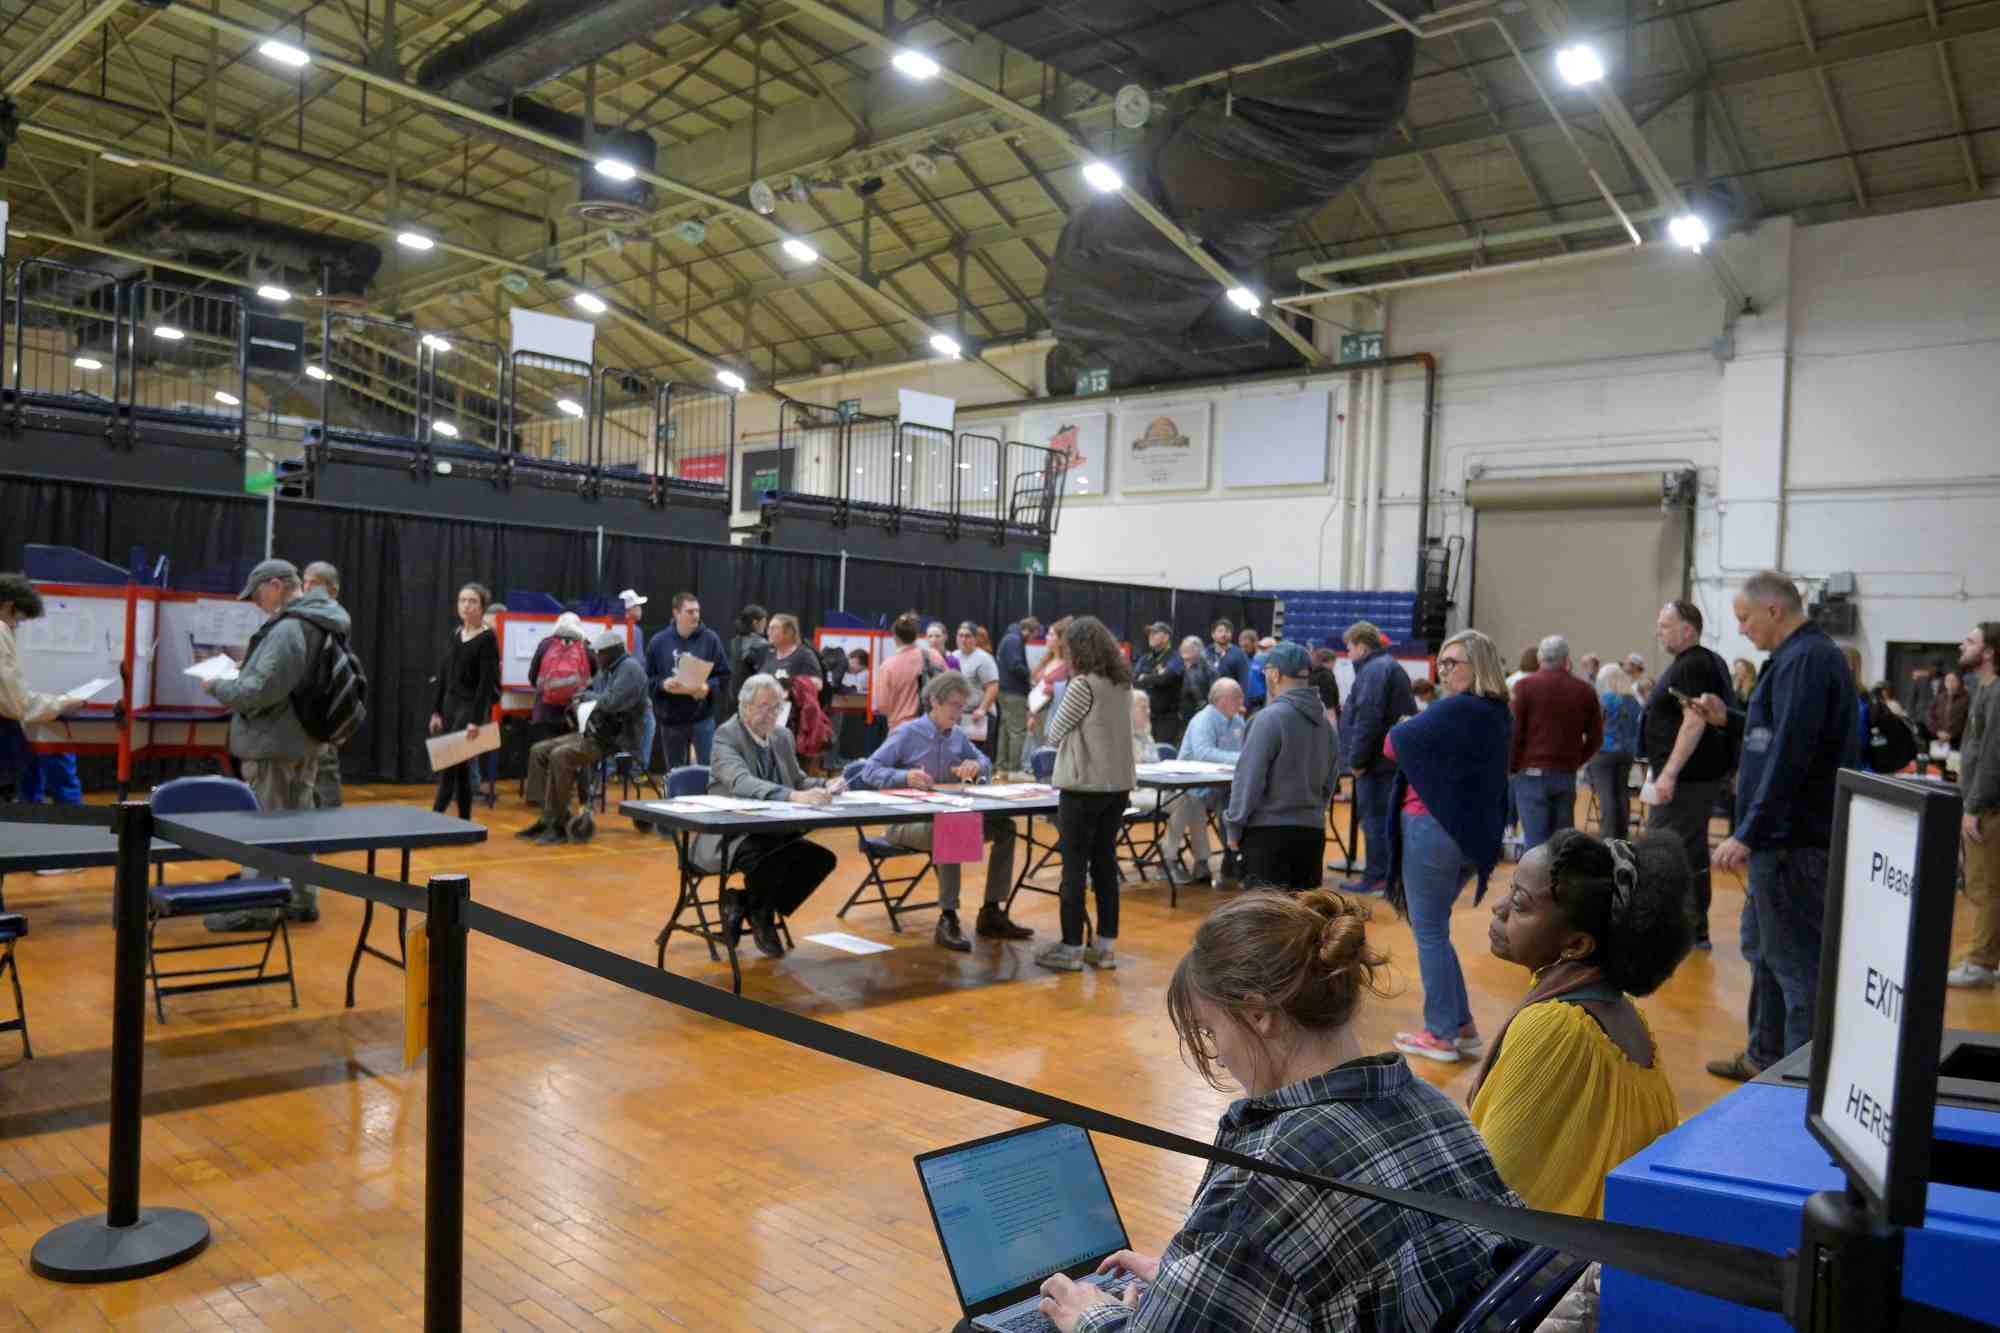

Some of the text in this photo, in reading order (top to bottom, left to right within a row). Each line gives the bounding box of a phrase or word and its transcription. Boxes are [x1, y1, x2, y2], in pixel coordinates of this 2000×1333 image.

[1360, 340, 1381, 359] 14
[1090, 375, 1107, 392] 13
[1865, 967, 1904, 1023] EXIT
